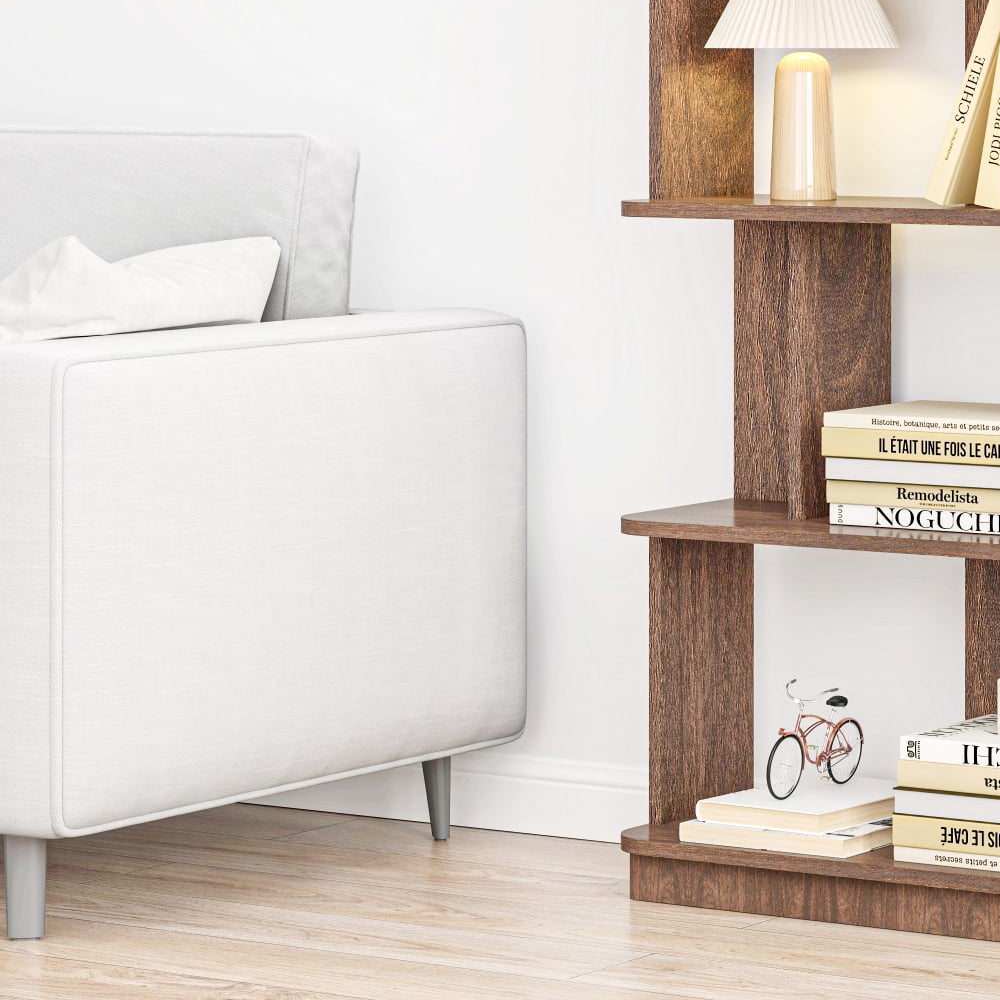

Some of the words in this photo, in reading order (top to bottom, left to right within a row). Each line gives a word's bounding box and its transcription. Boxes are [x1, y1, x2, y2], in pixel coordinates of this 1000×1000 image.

[954, 55, 986, 124] SCHIELE
[871, 418, 902, 428] Histoire,
[903, 419, 941, 430] botanique,
[968, 423, 990, 432] petits
[879, 438, 888, 453] IL
[890, 435, 918, 455] ÉTAIT
[921, 440, 941, 456] UNE
[944, 441, 966, 458] FOIS
[969, 443, 981, 458] LE
[897, 487, 979, 504] Remodelista
[940, 826, 969, 846] CAFÉ
[972, 830, 985, 847] LE
[934, 855, 963, 864] secrets
[965, 856, 988, 867] petits
[989, 859, 998, 868] et
